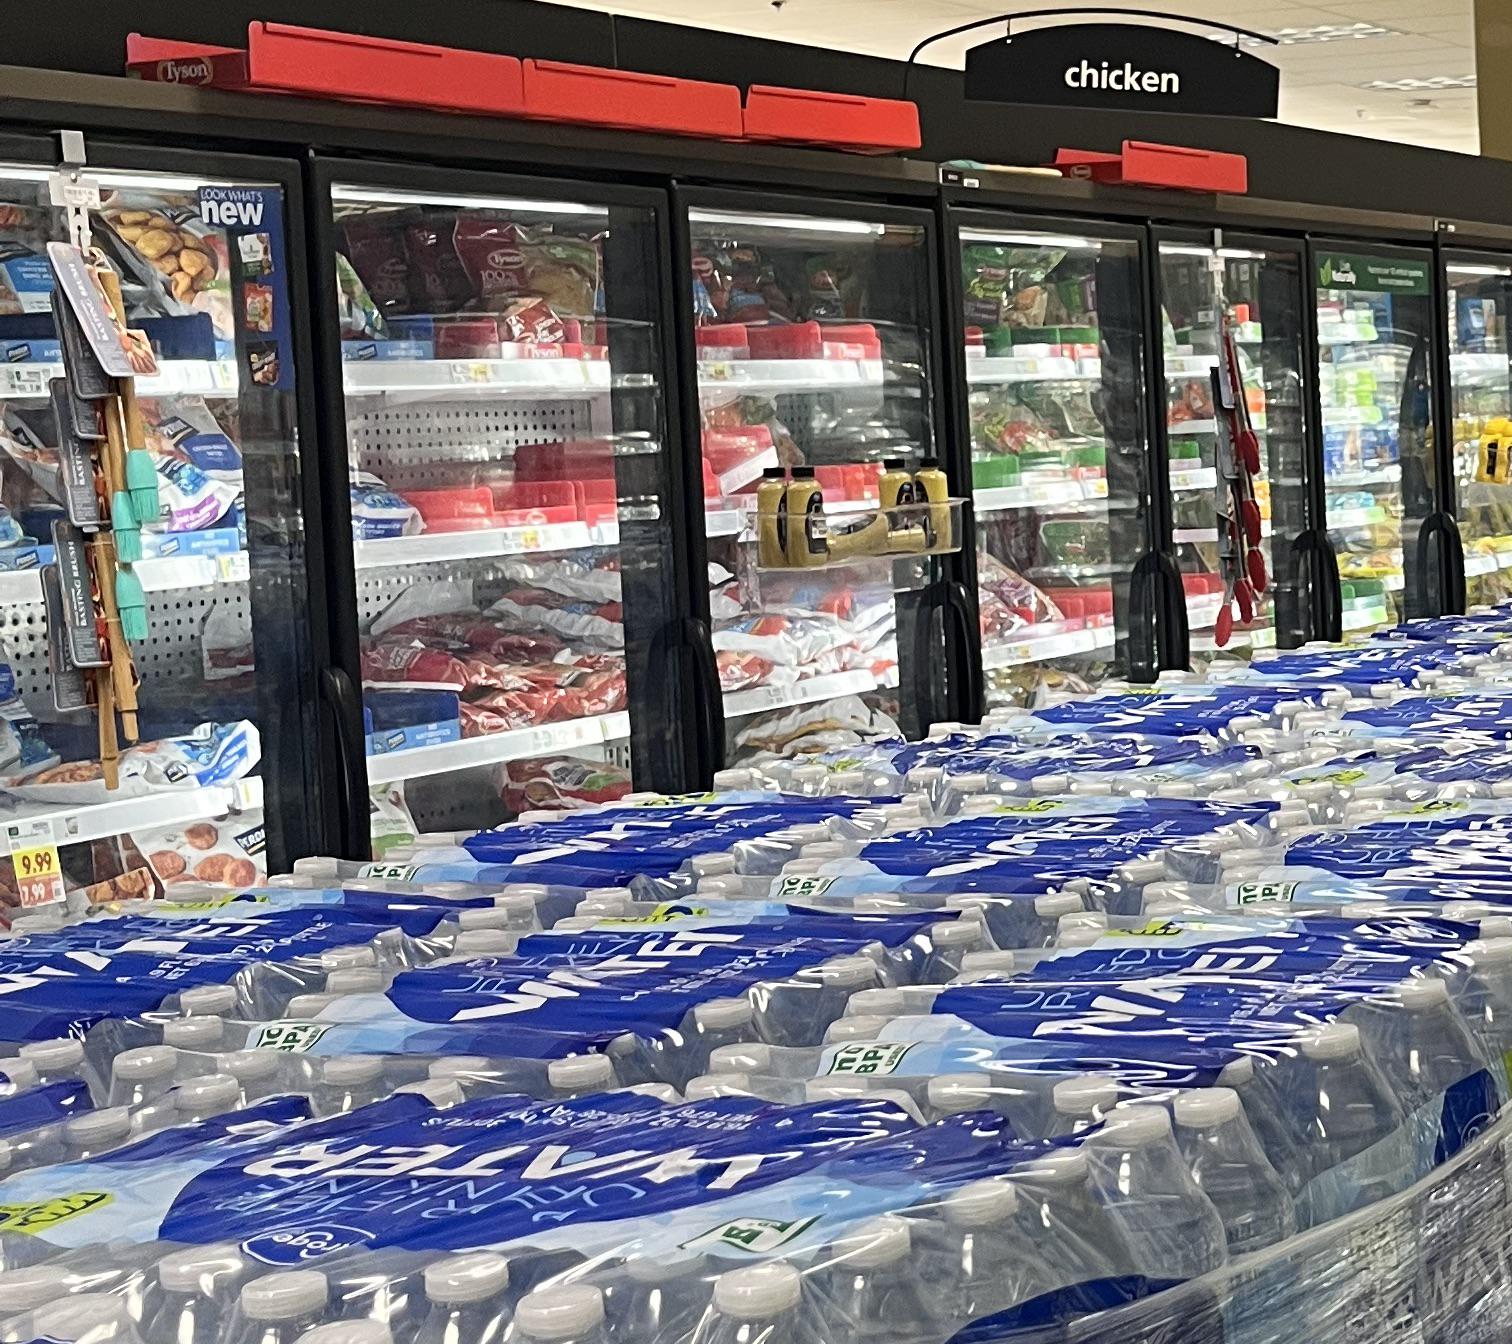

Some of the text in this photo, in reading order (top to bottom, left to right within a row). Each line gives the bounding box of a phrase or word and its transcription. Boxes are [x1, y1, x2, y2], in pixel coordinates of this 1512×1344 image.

[167, 59, 209, 84] Tyson
[1063, 59, 1180, 94] chicken
[200, 188, 228, 202] LOOK
[200, 199, 264, 226] new
[22, 851, 52, 874] 9.99
[242, 1143, 804, 1190] WATER
